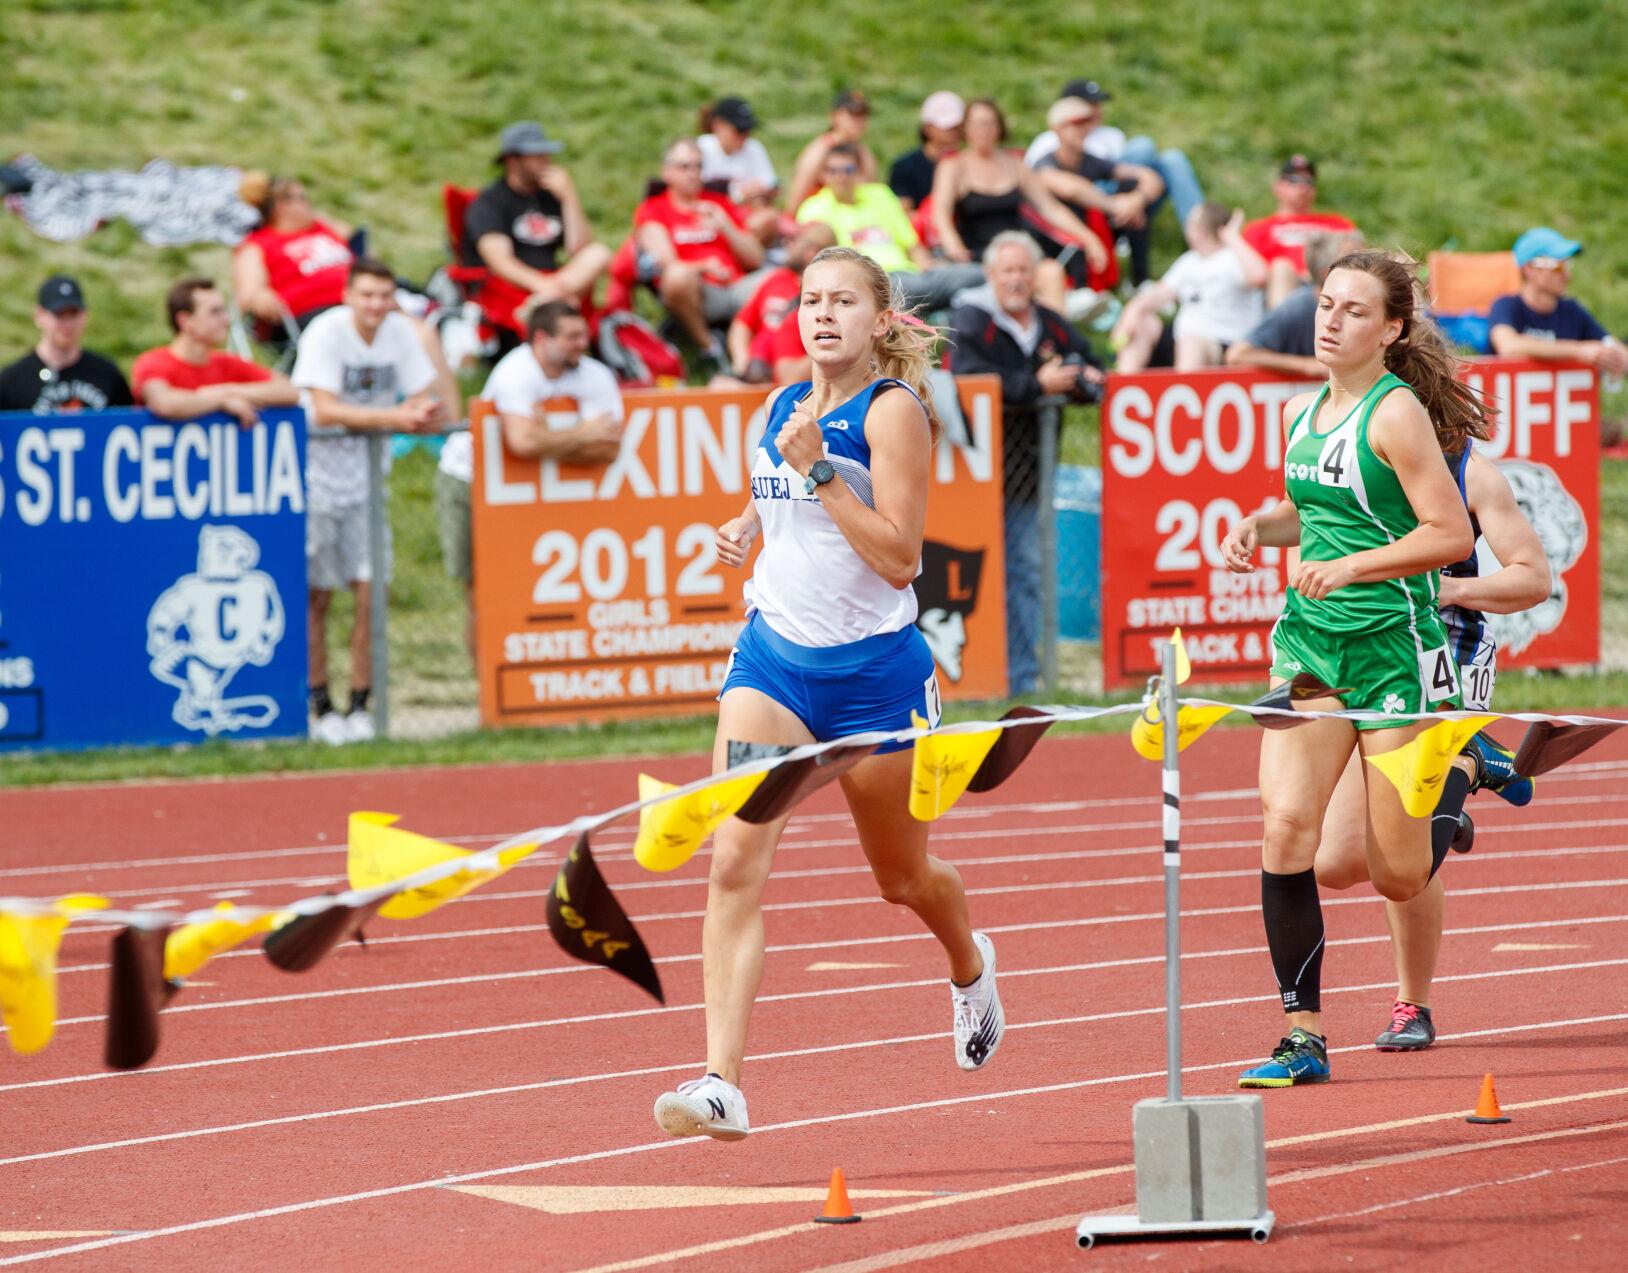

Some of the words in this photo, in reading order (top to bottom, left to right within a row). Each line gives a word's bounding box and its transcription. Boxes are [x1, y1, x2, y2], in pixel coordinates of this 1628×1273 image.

[1109, 370, 1594, 478] SCOTUFF
[482, 393, 993, 505] LEXINN
[1323, 438, 1344, 484] 4
[16, 426, 91, 526] ST.
[103, 420, 305, 523] CECILIA
[531, 522, 724, 604] 2012
[1209, 566, 1280, 598] BOYS
[217, 596, 238, 641] C
[587, 600, 671, 630] GIRLS
[1126, 597, 1205, 628] STATE
[503, 630, 588, 663] STATE
[592, 621, 746, 657] CHAMPION
[1149, 632, 1240, 666] TACK
[529, 669, 623, 711] TRACK
[628, 667, 649, 705] &
[1432, 649, 1455, 695] 4
[1469, 667, 1490, 702] 10
